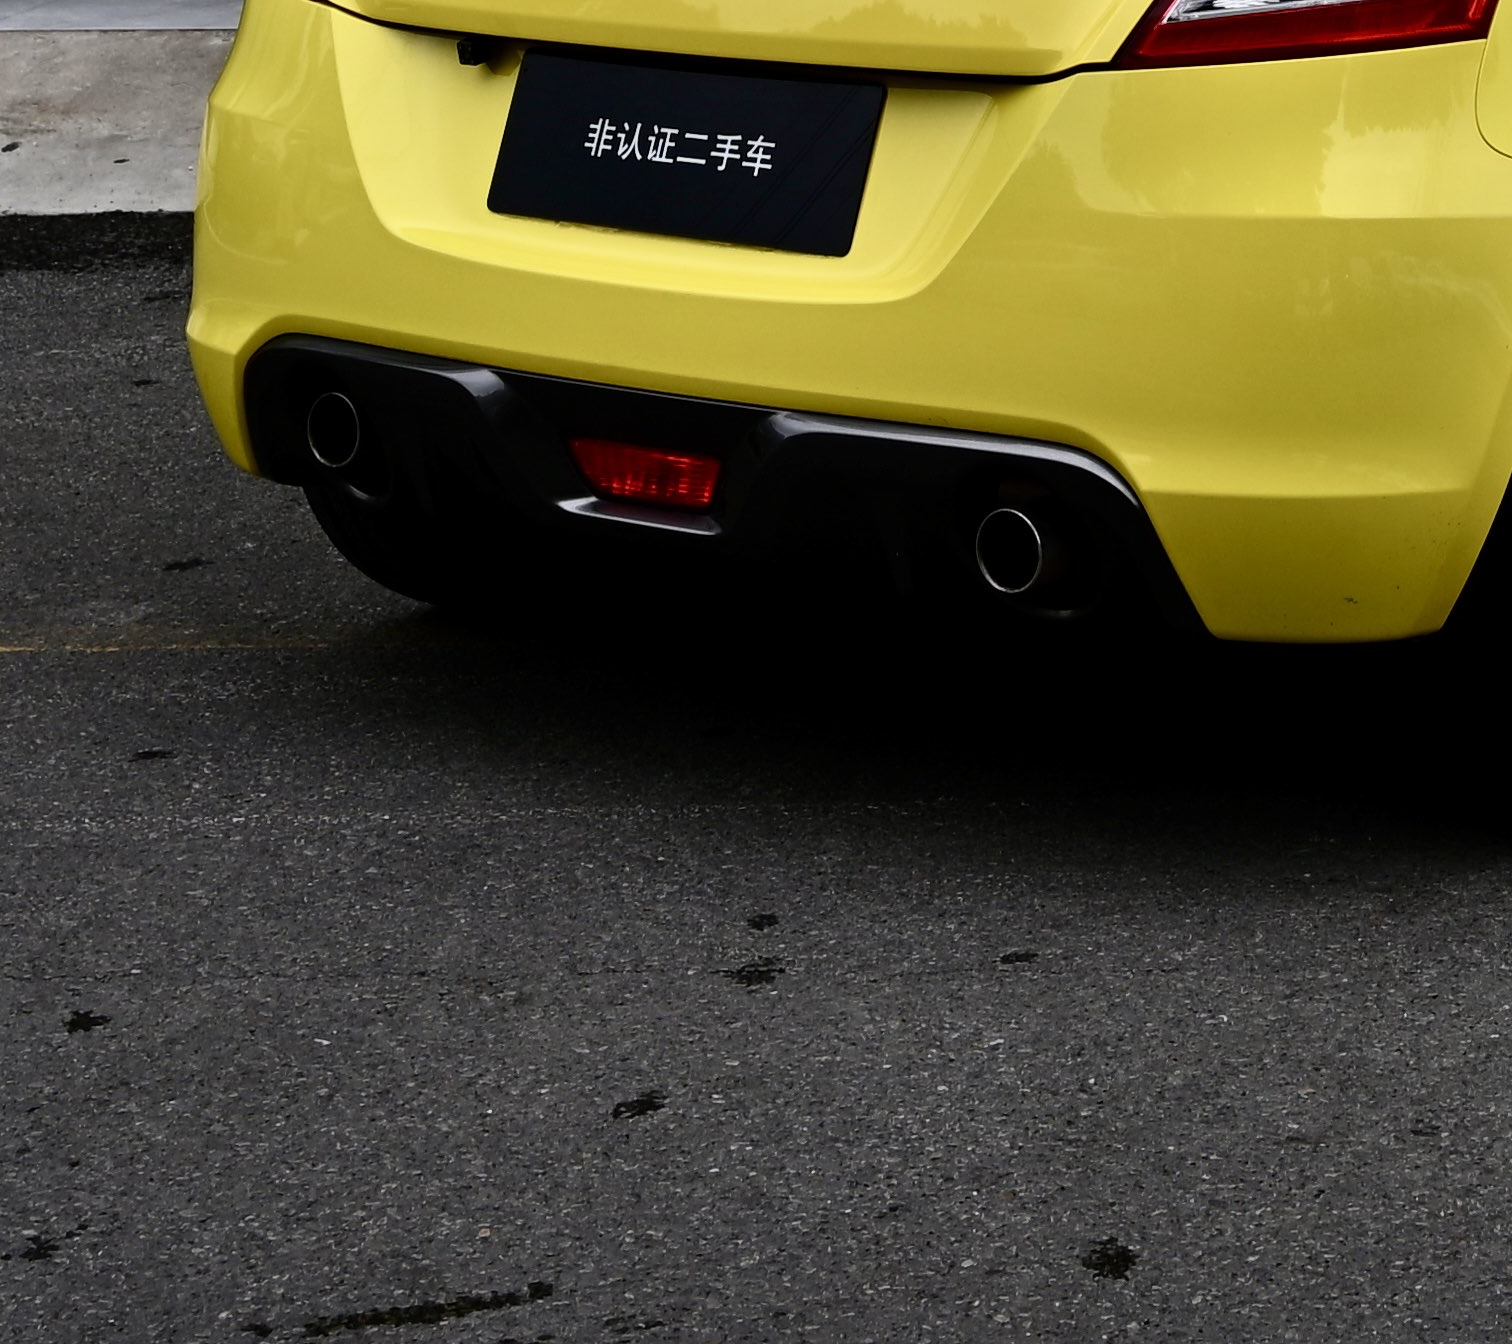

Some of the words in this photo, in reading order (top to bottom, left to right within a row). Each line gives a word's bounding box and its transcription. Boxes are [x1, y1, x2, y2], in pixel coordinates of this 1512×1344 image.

[584, 118, 776, 177] 非认证二手车
